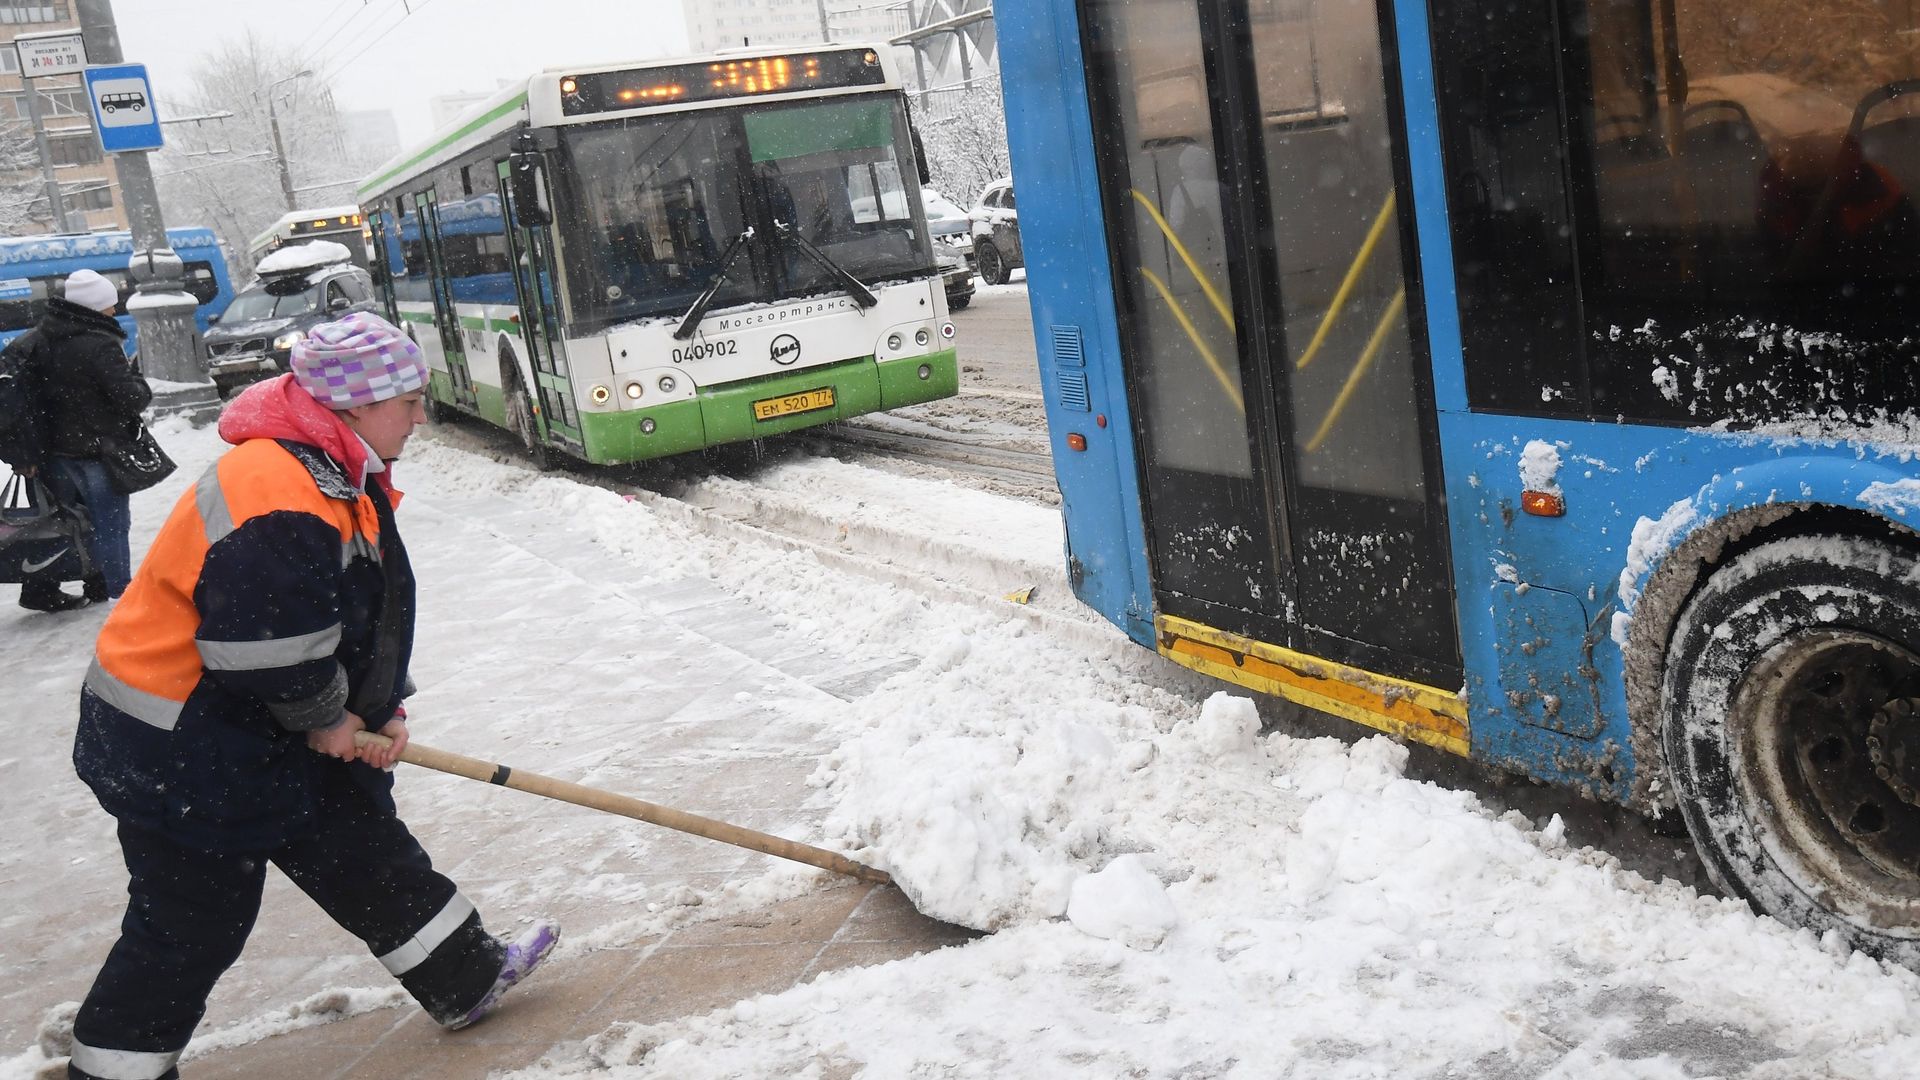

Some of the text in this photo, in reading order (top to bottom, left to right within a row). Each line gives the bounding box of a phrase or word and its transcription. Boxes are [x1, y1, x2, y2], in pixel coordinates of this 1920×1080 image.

[719, 299, 845, 331] Мосгортранс
[673, 339, 737, 364] 040902
[784, 396, 809, 411] 520
[816, 391, 827, 401] 77
